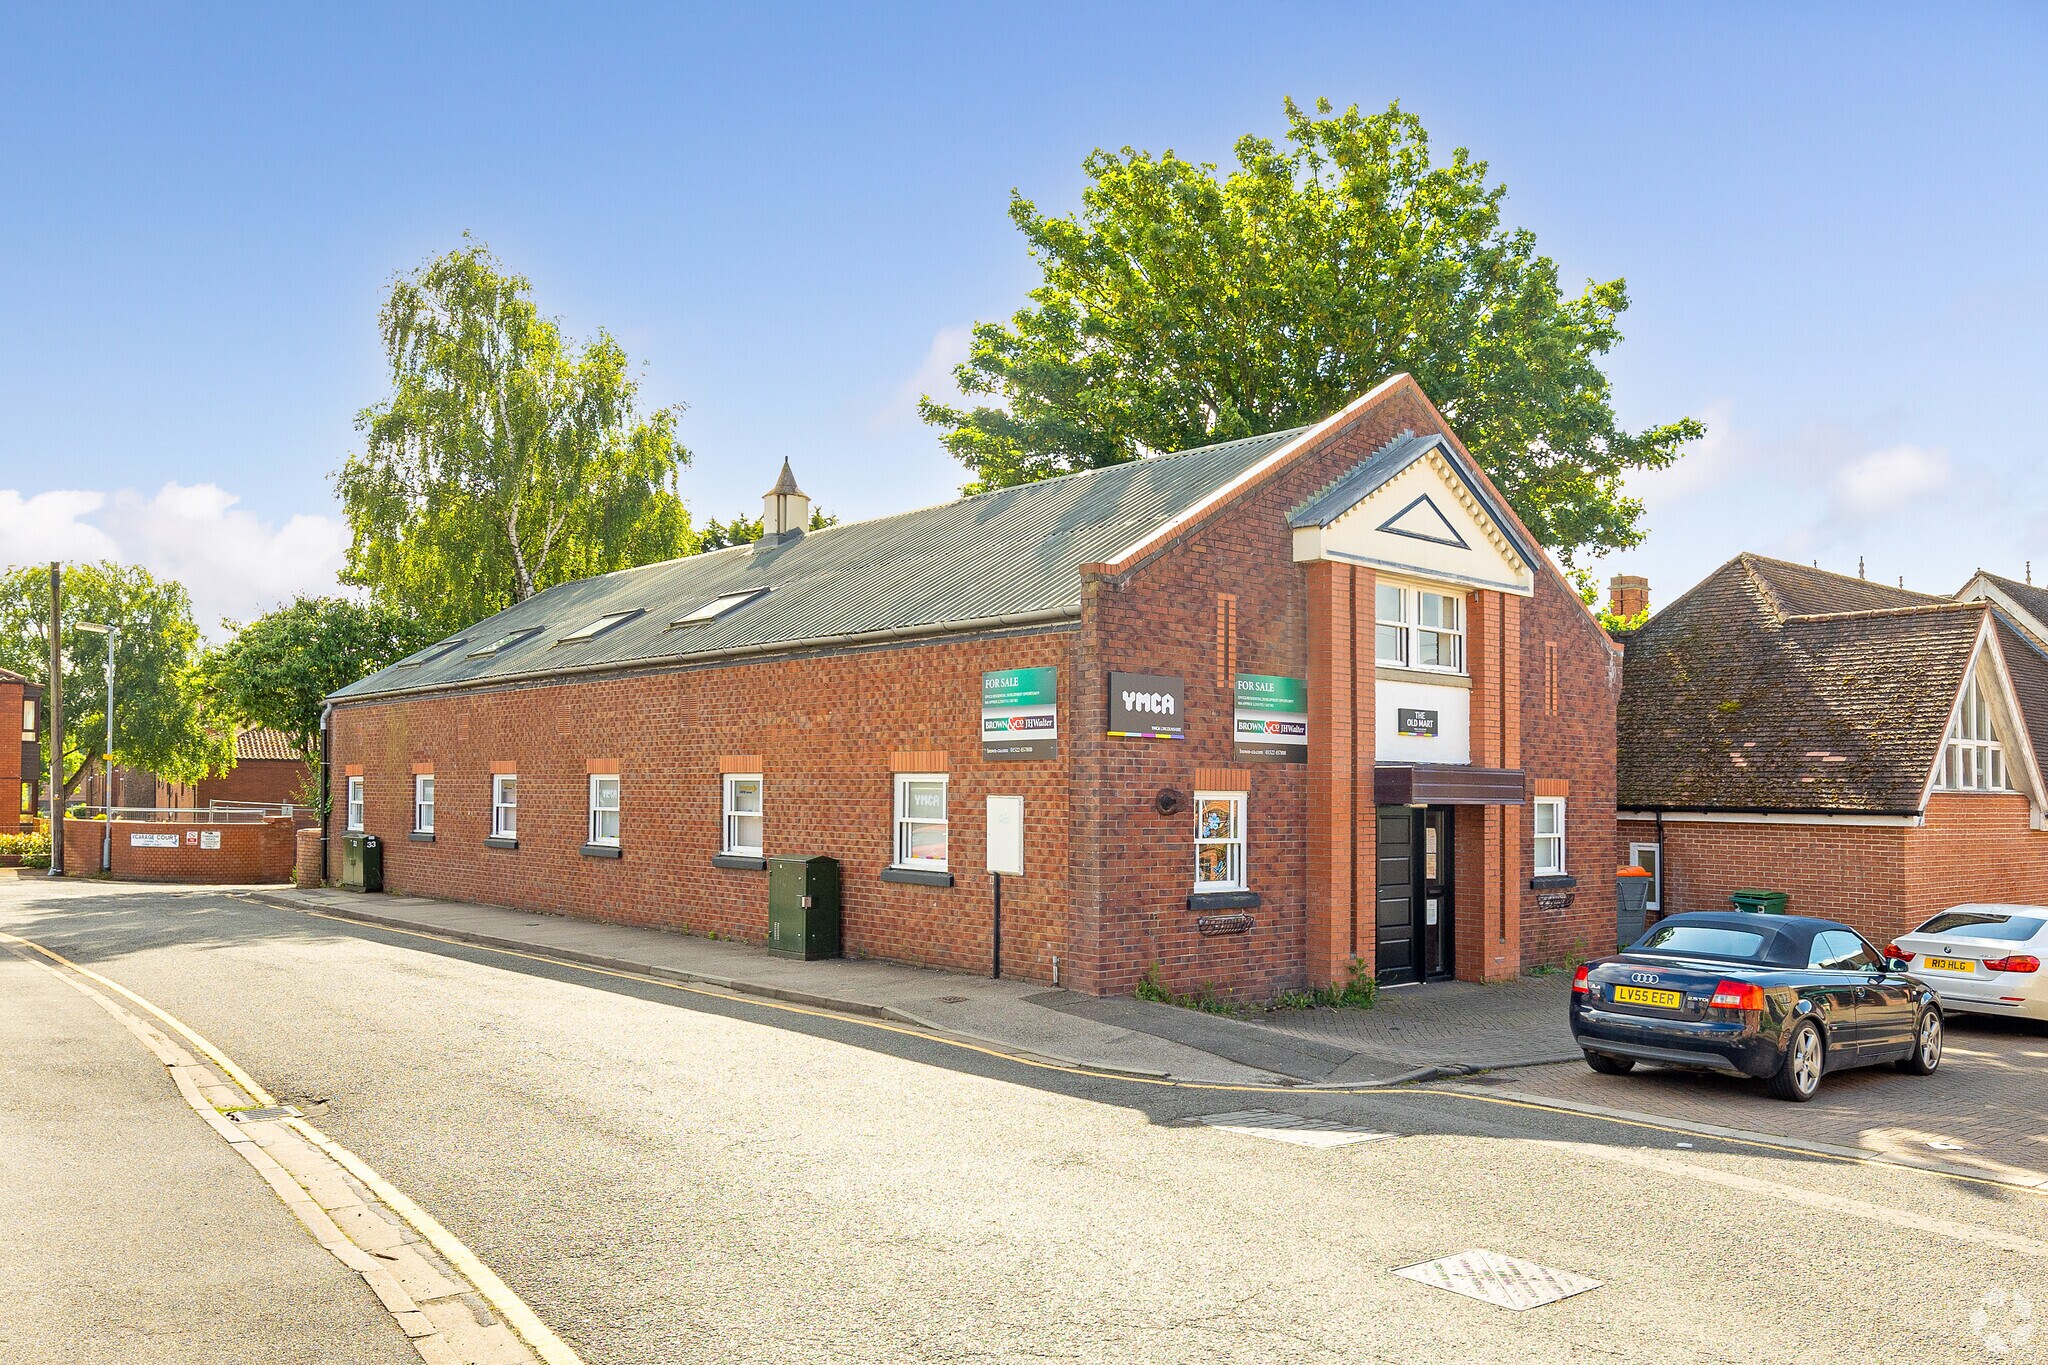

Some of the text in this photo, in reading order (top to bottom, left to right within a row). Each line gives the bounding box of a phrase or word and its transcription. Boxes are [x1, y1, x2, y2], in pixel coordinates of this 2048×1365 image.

[985, 677, 1019, 688] FOR SALE
[1237, 680, 1275, 692] FOR SALE
[1122, 690, 1175, 716] YMCA
[1415, 711, 1425, 719] THE
[1406, 719, 1418, 727] OLD
[914, 793, 940, 807] YMCA
[366, 840, 377, 849] 33
[1931, 958, 1966, 971] R13 HLG
[1620, 988, 1674, 1004] LV55 EER
